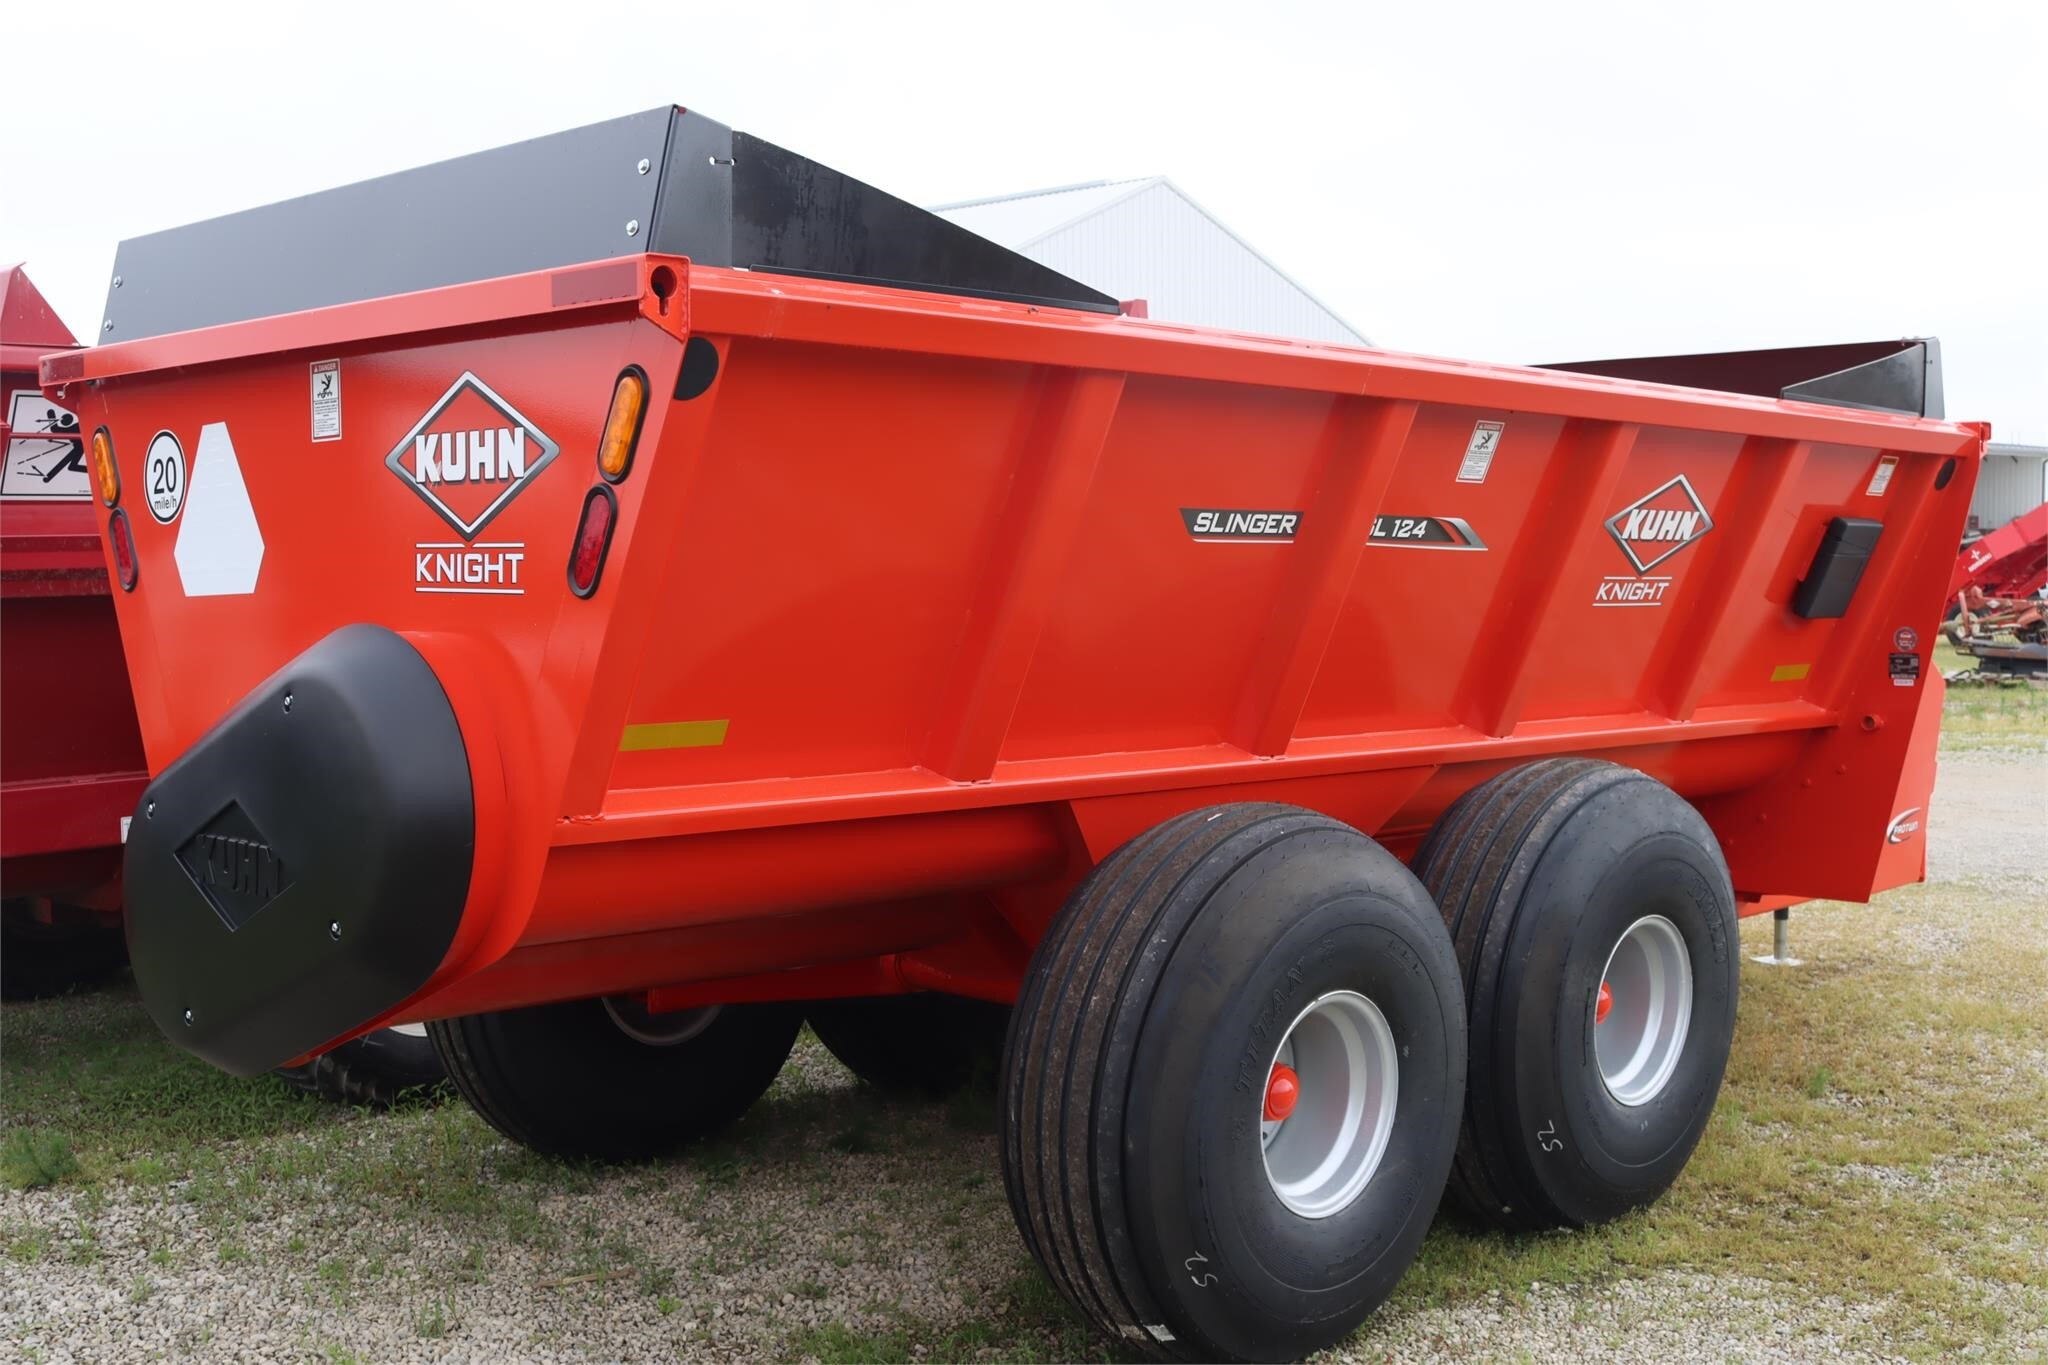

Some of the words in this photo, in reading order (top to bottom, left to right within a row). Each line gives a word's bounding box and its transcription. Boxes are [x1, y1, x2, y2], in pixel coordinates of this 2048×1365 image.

[415, 427, 525, 483] KUHN
[153, 456, 177, 494] 20
[154, 495, 177, 510] mile/h
[1193, 512, 1297, 534] SLINGER
[1369, 518, 1387, 537] L
[1391, 519, 1428, 538] 124
[1621, 509, 1700, 541] KUHN
[416, 553, 524, 583] KNIGHT
[1596, 583, 1669, 601] KNIGHT
[193, 833, 283, 899] KUHN
